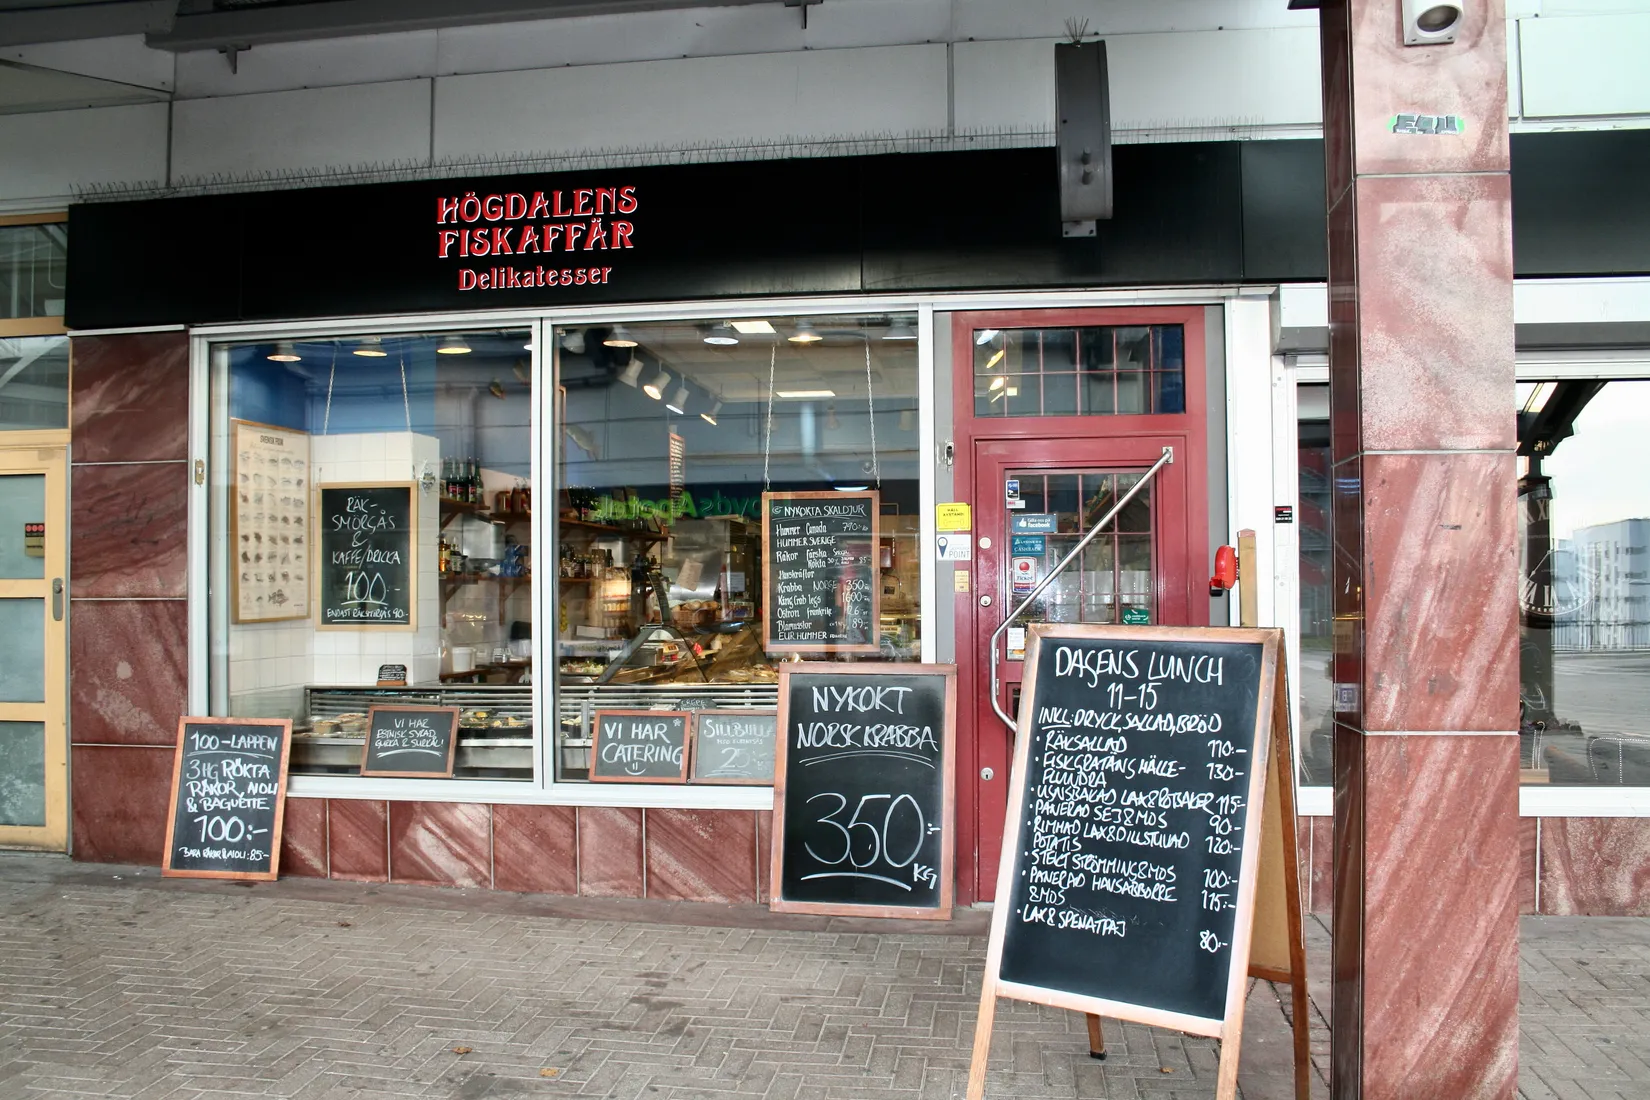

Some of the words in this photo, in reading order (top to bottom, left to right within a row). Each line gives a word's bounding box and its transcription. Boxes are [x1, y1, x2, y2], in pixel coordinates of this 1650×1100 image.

[436, 185, 638, 224] HÖGDALENS
[437, 217, 634, 258] FISKAFFÄR
[458, 265, 613, 291] Delikatesser
[332, 509, 395, 534] SMÖRGÅS
[784, 505, 822, 517] NYKOKTA
[351, 530, 368, 547] &
[775, 523, 800, 537] Hummer
[805, 520, 827, 535] Canada
[776, 537, 808, 548] HUMMER
[809, 535, 836, 546] SVERIGE
[949, 550, 969, 558] POINT
[777, 581, 803, 593] Krabba
[813, 580, 838, 592] NORGE
[778, 594, 794, 609] King
[808, 594, 822, 609] legs
[327, 608, 351, 618] ENDAST
[778, 632, 795, 640] EUR
[796, 631, 828, 640] HUMMER
[1055, 646, 1139, 688] DAGENS
[1148, 651, 1223, 685] LUNCH
[812, 686, 912, 714] NYKOKT
[1107, 682, 1163, 710] 11-15
[394, 718, 405, 728] VI
[408, 718, 431, 728] HAR
[604, 722, 621, 739] VI
[631, 723, 671, 744] HAR
[190, 730, 279, 751] 100-LAPPEN
[374, 739, 399, 749] GURKA
[797, 722, 861, 749] NORSK
[863, 724, 938, 751] KRABBA
[1045, 730, 1128, 753] RÄKSALLAD
[602, 742, 684, 771] CATERING
[221, 758, 271, 780] RÖKTA
[1042, 768, 1107, 787] FLUNDRA
[247, 782, 279, 796] AIOLI
[186, 798, 199, 813] &
[199, 797, 270, 811] BAGUETTE
[1035, 799, 1089, 818] PANERAD
[193, 815, 269, 843] 100:-
[179, 846, 201, 858] BARA
[1033, 831, 1082, 852] POTATIS
[1031, 849, 1071, 870] STEKT
[913, 863, 938, 889] KG
[1030, 866, 1085, 889] PANERAD
[1091, 876, 1178, 902] HAVSABBORRE
[1058, 911, 1126, 937] SPENATPAJ
